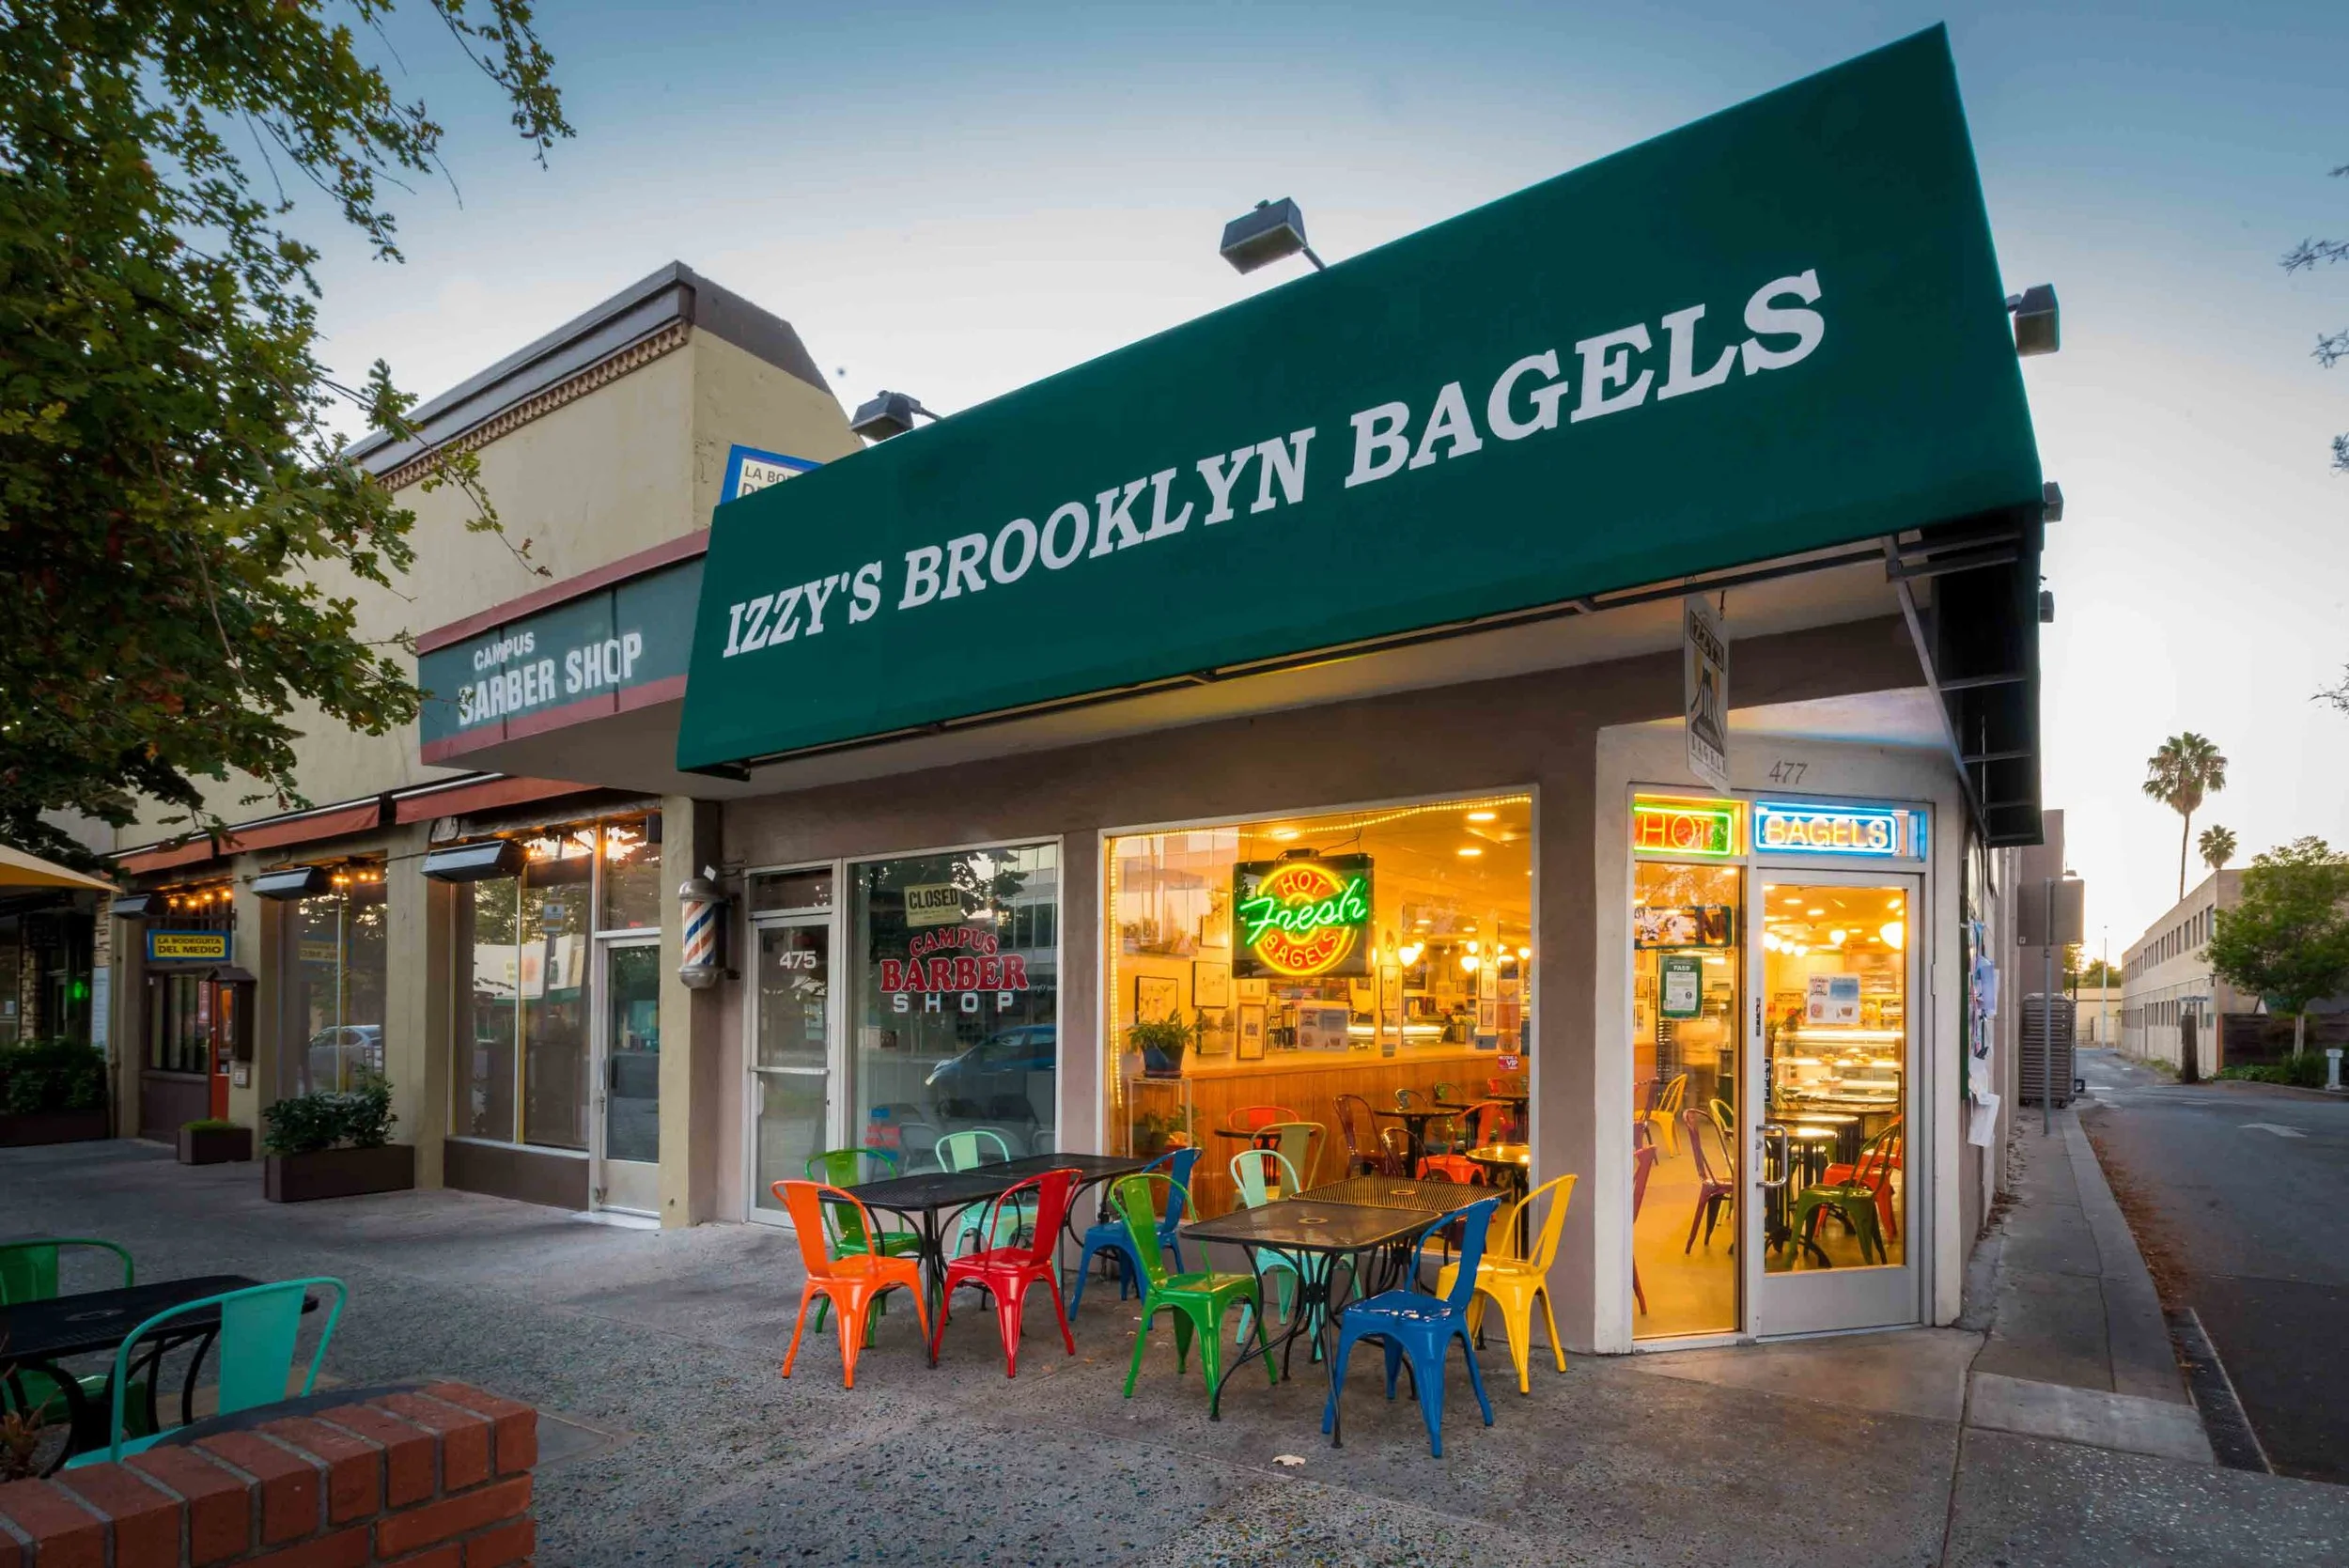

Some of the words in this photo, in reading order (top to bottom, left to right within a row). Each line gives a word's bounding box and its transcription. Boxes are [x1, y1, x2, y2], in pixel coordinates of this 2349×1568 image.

[723, 560, 883, 659] IZZY'S
[897, 427, 1317, 611] BROOKLYN
[1345, 269, 1826, 489] BAGELS
[744, 464, 763, 481] LA
[474, 631, 535, 671] CAMPUS
[459, 659, 556, 726] BARBER
[566, 632, 643, 693] SHOP
[1768, 760, 1809, 785] 477
[1641, 814, 1713, 847] HOT
[1764, 815, 1889, 848] BAGELS
[909, 888, 958, 909] CLOSED
[1280, 871, 1328, 895] HOT
[1239, 877, 1367, 944] Fresh
[158, 945, 179, 954] DEL
[182, 945, 222, 954] MEDIO
[909, 927, 999, 957] CAMPUS
[1264, 930, 1338, 967] BAGELS
[779, 950, 817, 970] 475
[879, 954, 1030, 992] BARBER
[893, 992, 1014, 1014] SHOP
